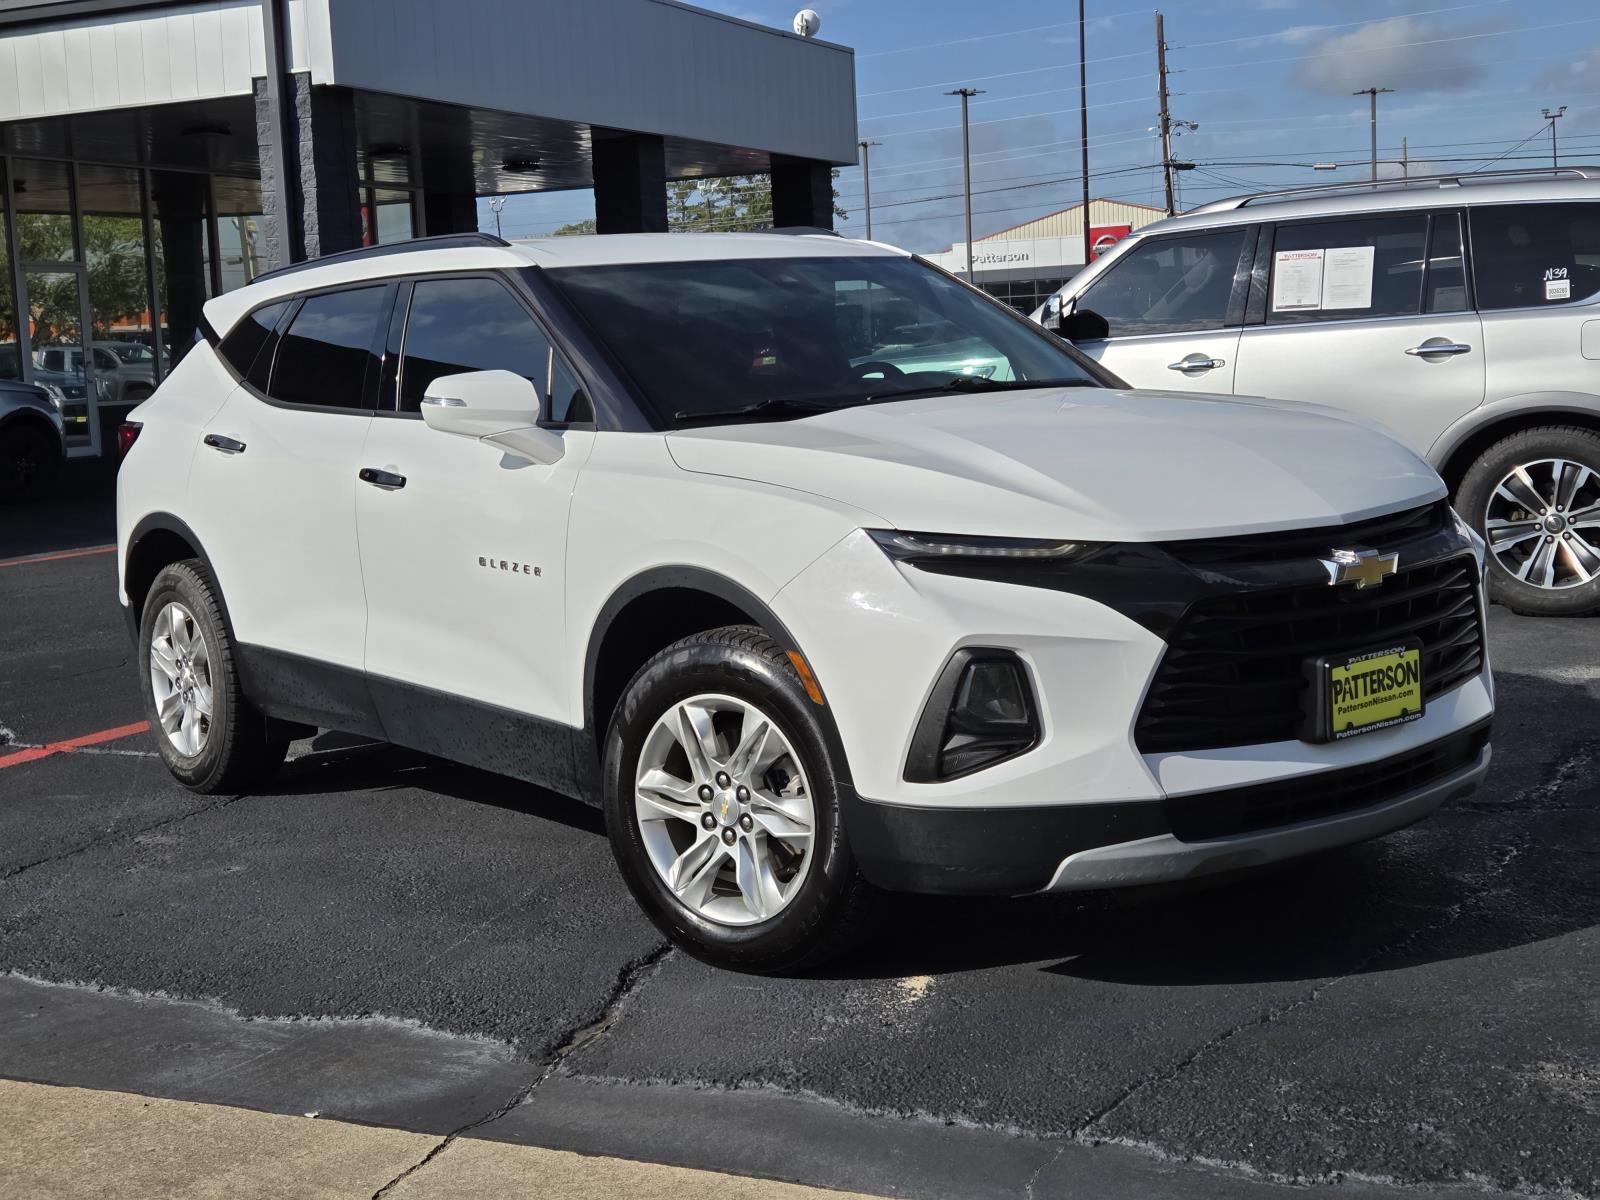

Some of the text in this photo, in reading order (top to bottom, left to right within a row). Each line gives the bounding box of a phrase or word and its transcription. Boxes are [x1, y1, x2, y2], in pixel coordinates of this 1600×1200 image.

[971, 252, 1029, 264] Patterson
[1543, 267, 1567, 280] N39
[478, 556, 542, 577] BLAZER
[1348, 646, 1406, 664] PATTERSON
[1331, 659, 1419, 704] PATTERSON
[1338, 689, 1414, 715] PattersonNissan.com
[1336, 713, 1422, 740] PattersonNissan.com
